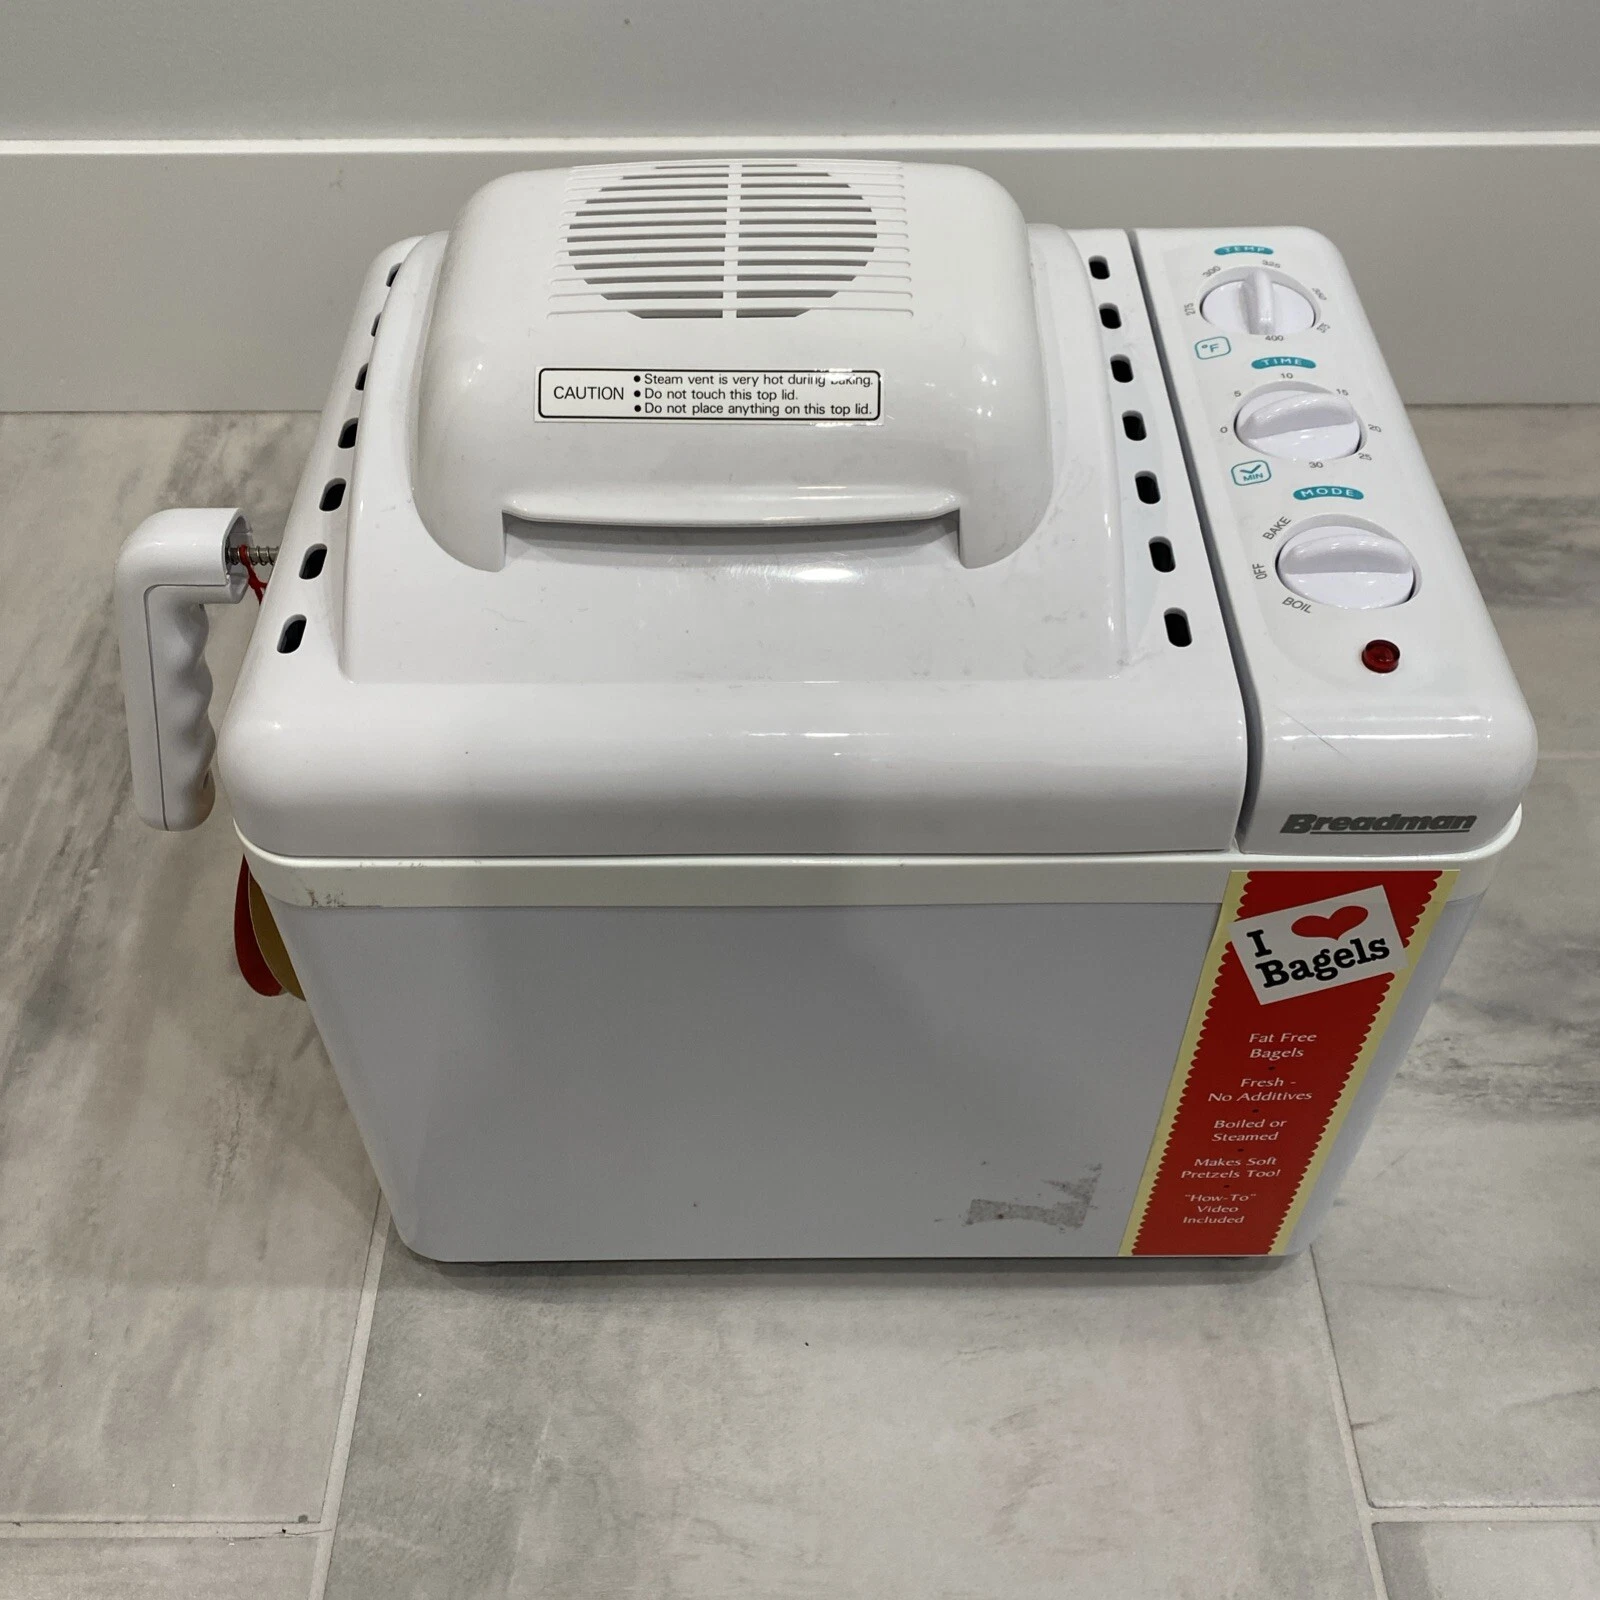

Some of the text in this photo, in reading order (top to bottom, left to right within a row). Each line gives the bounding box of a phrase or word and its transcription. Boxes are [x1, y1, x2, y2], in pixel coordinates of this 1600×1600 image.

[1262, 358, 1302, 366] TIME
[644, 373, 682, 386] Steam
[687, 375, 713, 386] vent
[718, 374, 729, 386] is
[732, 376, 759, 389] very
[763, 375, 784, 387] hot
[1281, 372, 1294, 380] 10
[553, 386, 625, 400] CAUTION
[644, 388, 799, 403] Do not touch this top lid.
[1234, 390, 1242, 398] 5
[1336, 388, 1349, 397] 15
[644, 403, 873, 418] Do not place anything on this top lid.
[1220, 426, 1228, 434] 0
[1368, 424, 1382, 433] 20
[1358, 453, 1373, 462] 25
[1309, 461, 1324, 469] 30
[1242, 472, 1264, 482] MIN
[1301, 487, 1354, 498] MODE
[1262, 516, 1292, 541] BAKE
[1252, 563, 1268, 581] OFF
[1281, 596, 1312, 614] BOIL
[1280, 814, 1477, 835] Breadman
[1247, 929, 1272, 958] I
[1255, 938, 1390, 989] Bagels
[1249, 1032, 1317, 1043] Fat Free
[1250, 1047, 1304, 1061] Bagels
[1240, 1078, 1284, 1088] Fresh
[1207, 1091, 1313, 1102] No Additives
[1213, 1119, 1287, 1129] Boiled or
[1211, 1132, 1279, 1142] Steamed
[1194, 1157, 1277, 1167] Makes Soft
[1180, 1169, 1281, 1179] Pretzels Too!
[1197, 1205, 1239, 1213] Video
[1182, 1216, 1245, 1224] Included
